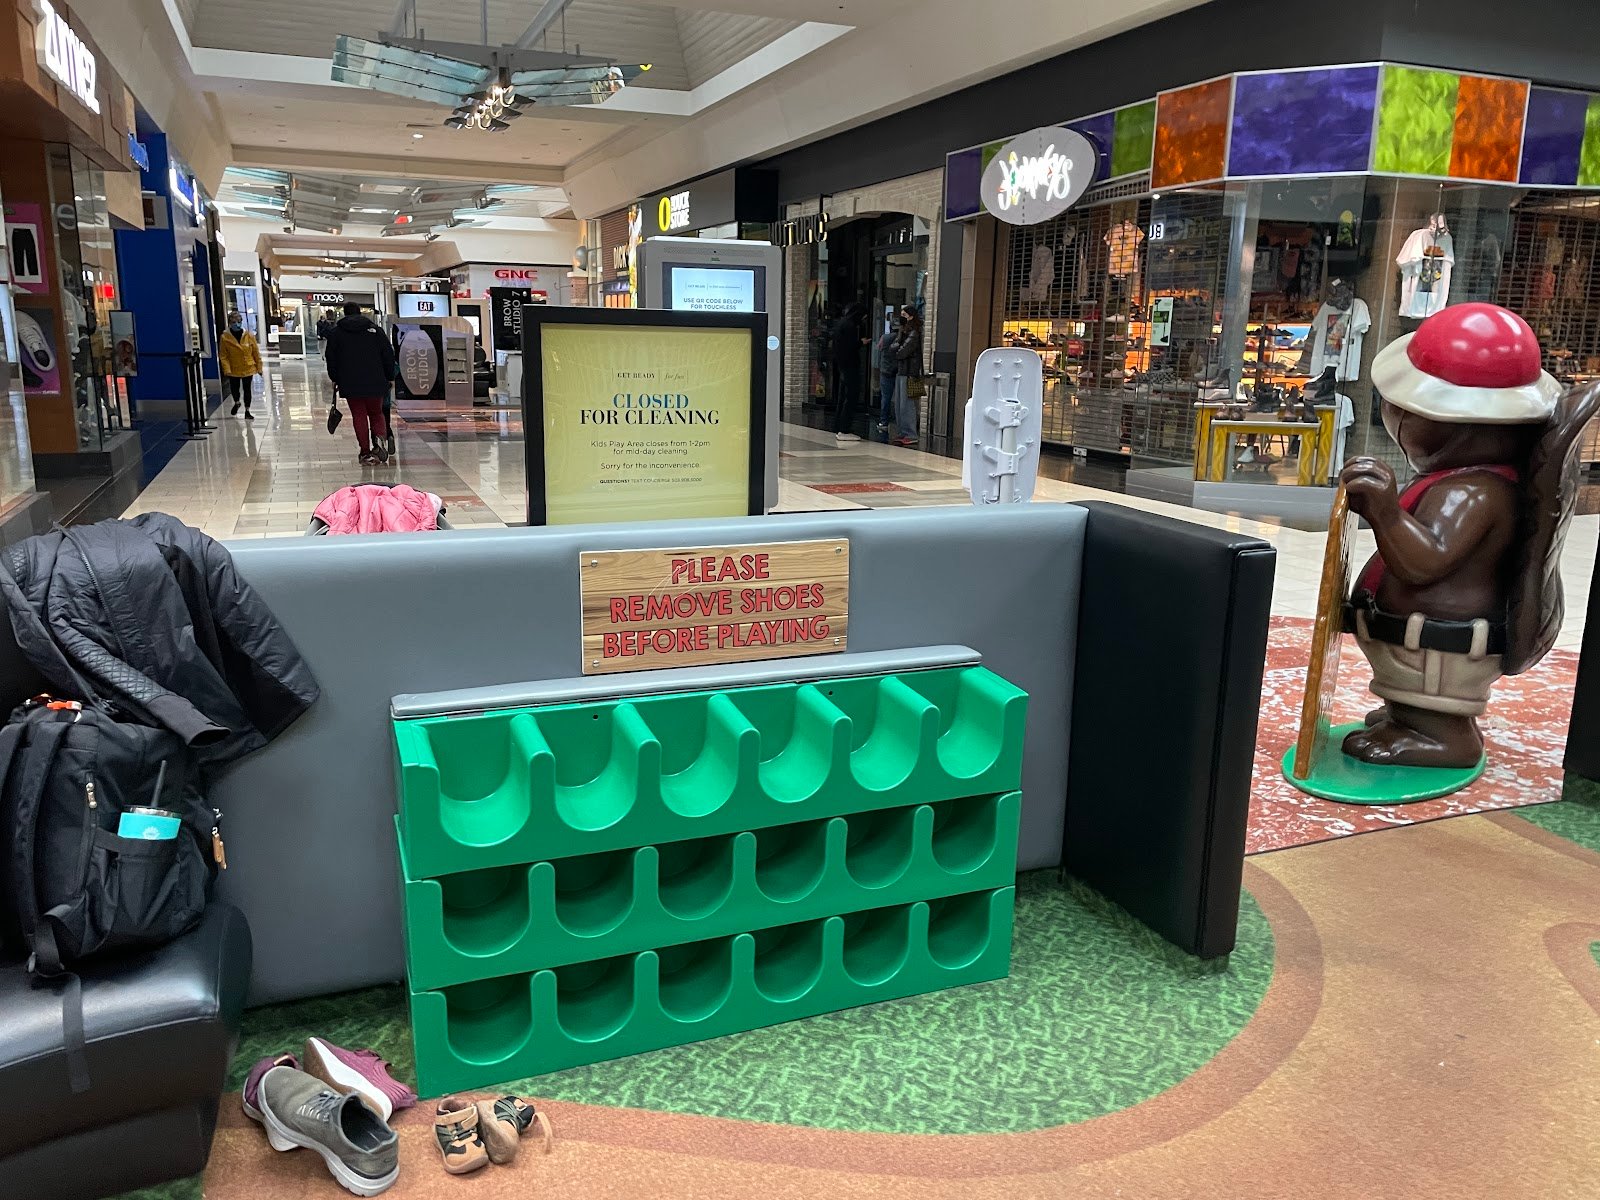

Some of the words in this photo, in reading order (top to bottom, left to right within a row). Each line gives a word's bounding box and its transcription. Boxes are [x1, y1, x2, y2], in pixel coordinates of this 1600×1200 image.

[494, 269, 538, 280] GNC
[312, 293, 344, 303] macy's
[419, 301, 431, 311] EAT
[503, 298, 512, 327] BROW
[512, 299, 521, 335] STUDIO
[406, 350, 417, 380] BROW
[418, 348, 430, 389] STUDIO
[613, 393, 689, 409] CLOSED
[580, 409, 618, 425] FOR
[625, 409, 719, 425] CLEANING
[609, 440, 625, 449] Play
[689, 440, 711, 448] 1-2pm
[600, 462, 621, 470] Sorry
[671, 553, 770, 585] PLEASE
[610, 589, 733, 623] REMOVE
[740, 583, 825, 614] SHOES
[603, 625, 709, 658] BEFORE
[717, 615, 830, 649] PLAYING
